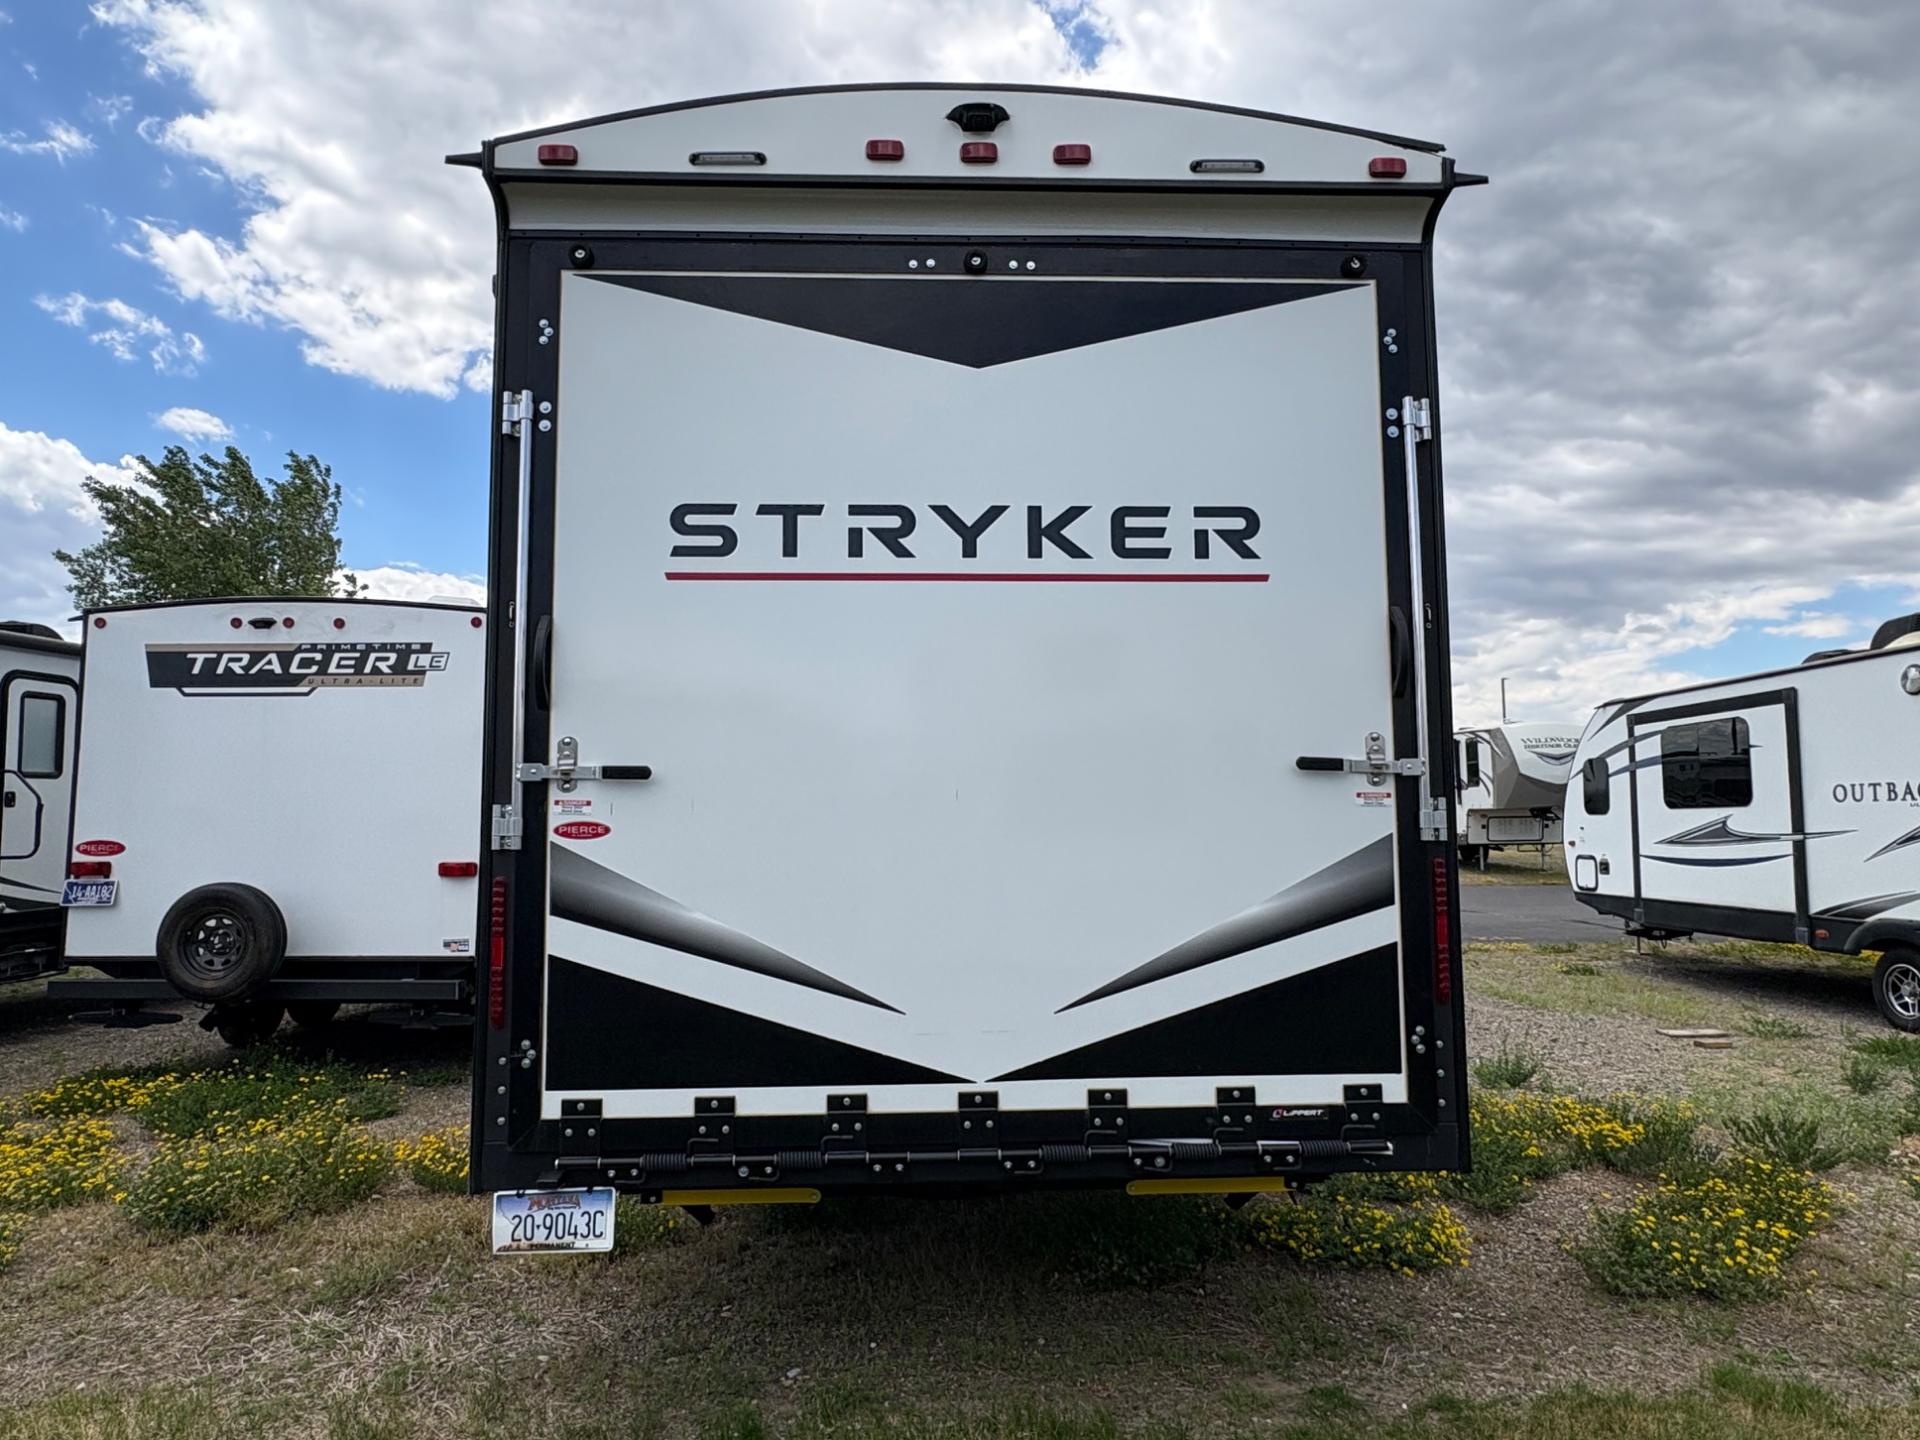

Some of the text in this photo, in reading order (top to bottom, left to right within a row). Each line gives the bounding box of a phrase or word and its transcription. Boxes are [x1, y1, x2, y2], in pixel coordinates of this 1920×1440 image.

[669, 503, 1262, 560] STRYKER
[186, 652, 447, 675] TRACER LE
[308, 677, 418, 685] ULTRA-LITE
[1832, 780, 1920, 803] OUTBA
[558, 825, 606, 834] PIERCE
